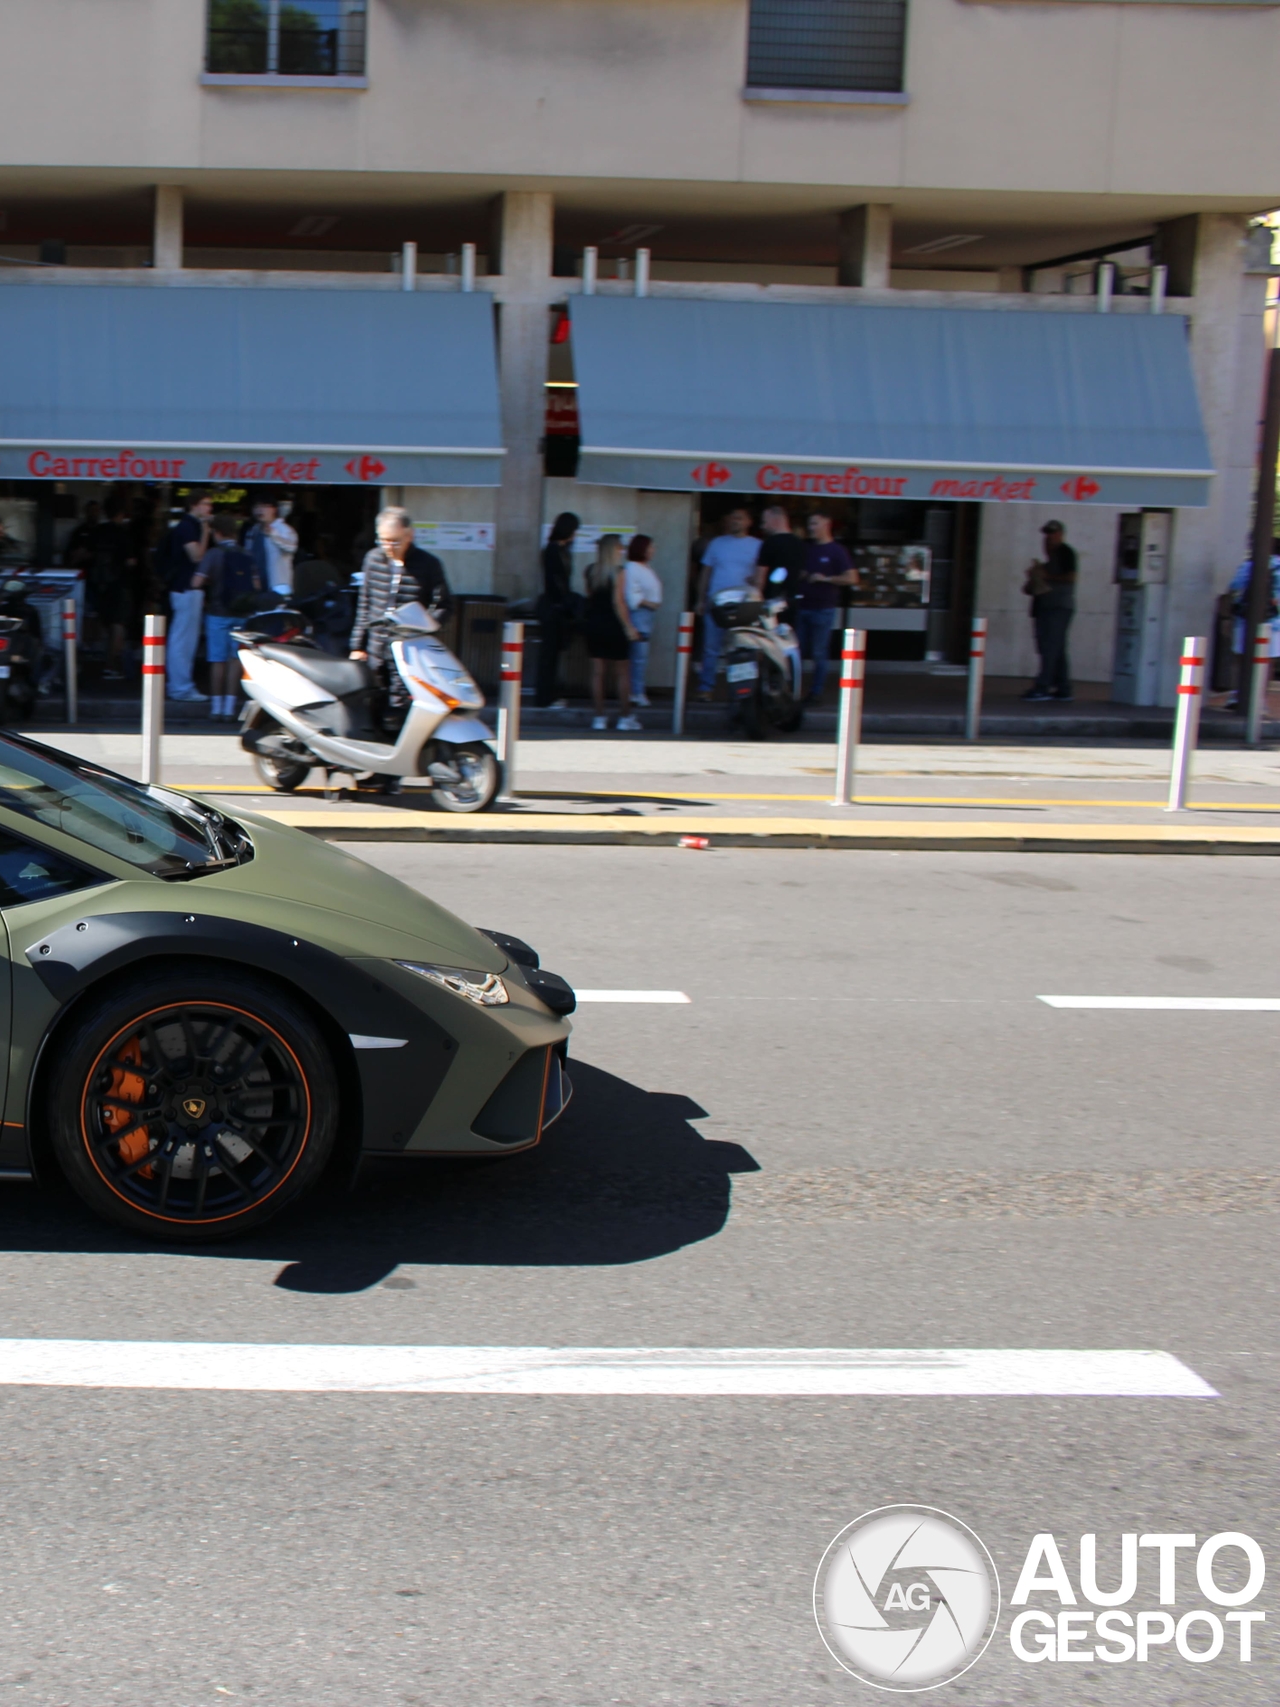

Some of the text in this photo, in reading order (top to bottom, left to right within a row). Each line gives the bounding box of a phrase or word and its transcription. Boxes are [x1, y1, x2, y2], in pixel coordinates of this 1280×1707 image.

[28, 450, 321, 483] Carrefour market
[755, 464, 1038, 502] Carrefour market
